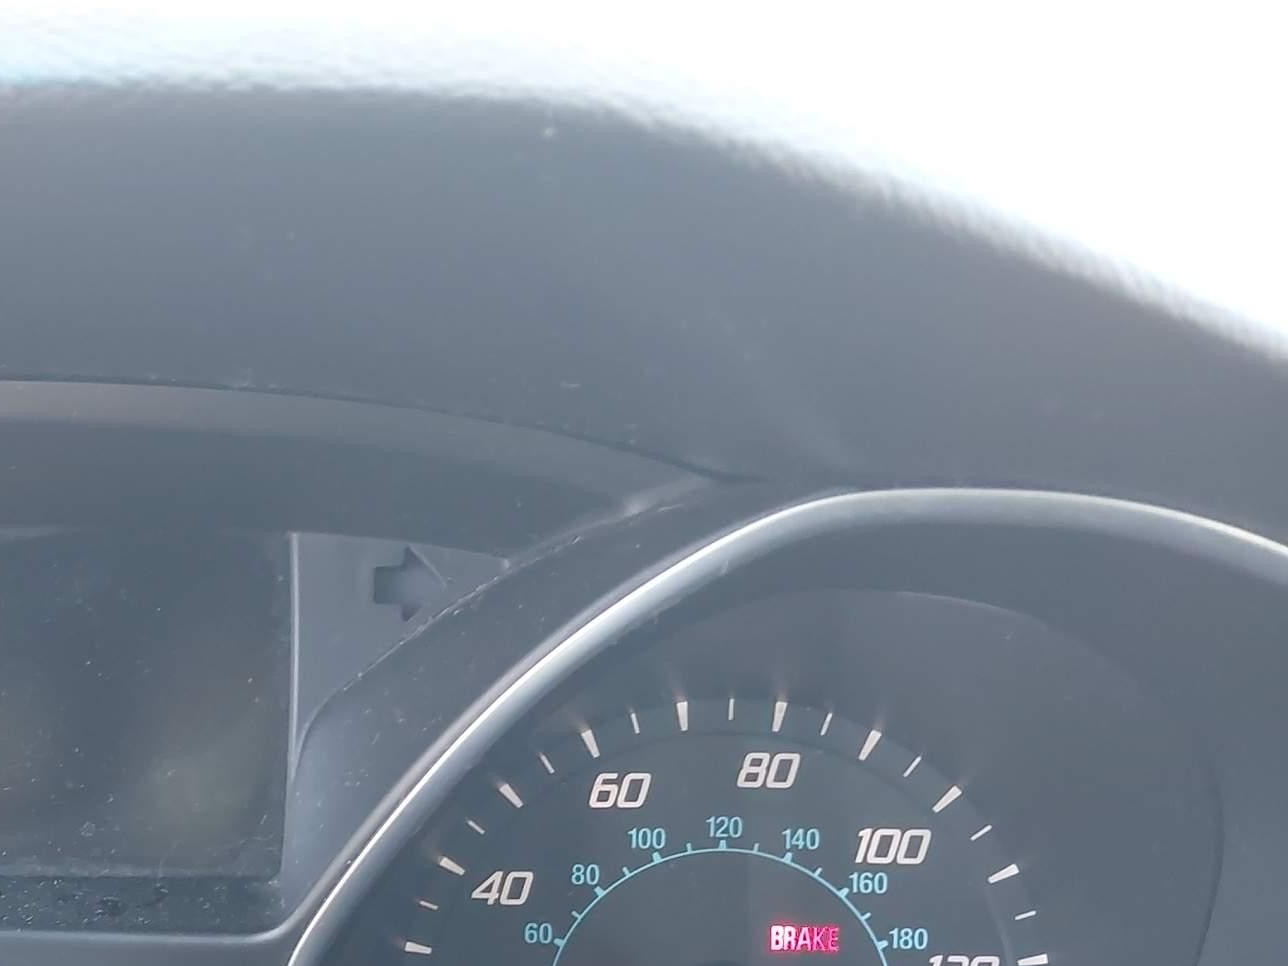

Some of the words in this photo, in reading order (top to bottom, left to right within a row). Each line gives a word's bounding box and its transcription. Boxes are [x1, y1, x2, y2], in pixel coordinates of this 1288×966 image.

[737, 753, 800, 789] 80
[589, 773, 651, 808] 60
[627, 827, 666, 851] 100
[706, 816, 743, 840] 120
[782, 828, 820, 852] 140
[855, 829, 931, 864] 100
[571, 864, 600, 886] 80
[848, 872, 888, 896] 160
[472, 872, 533, 905] 40
[525, 922, 553, 945] 60
[770, 924, 841, 953] BRAKE
[889, 927, 928, 951] 180
